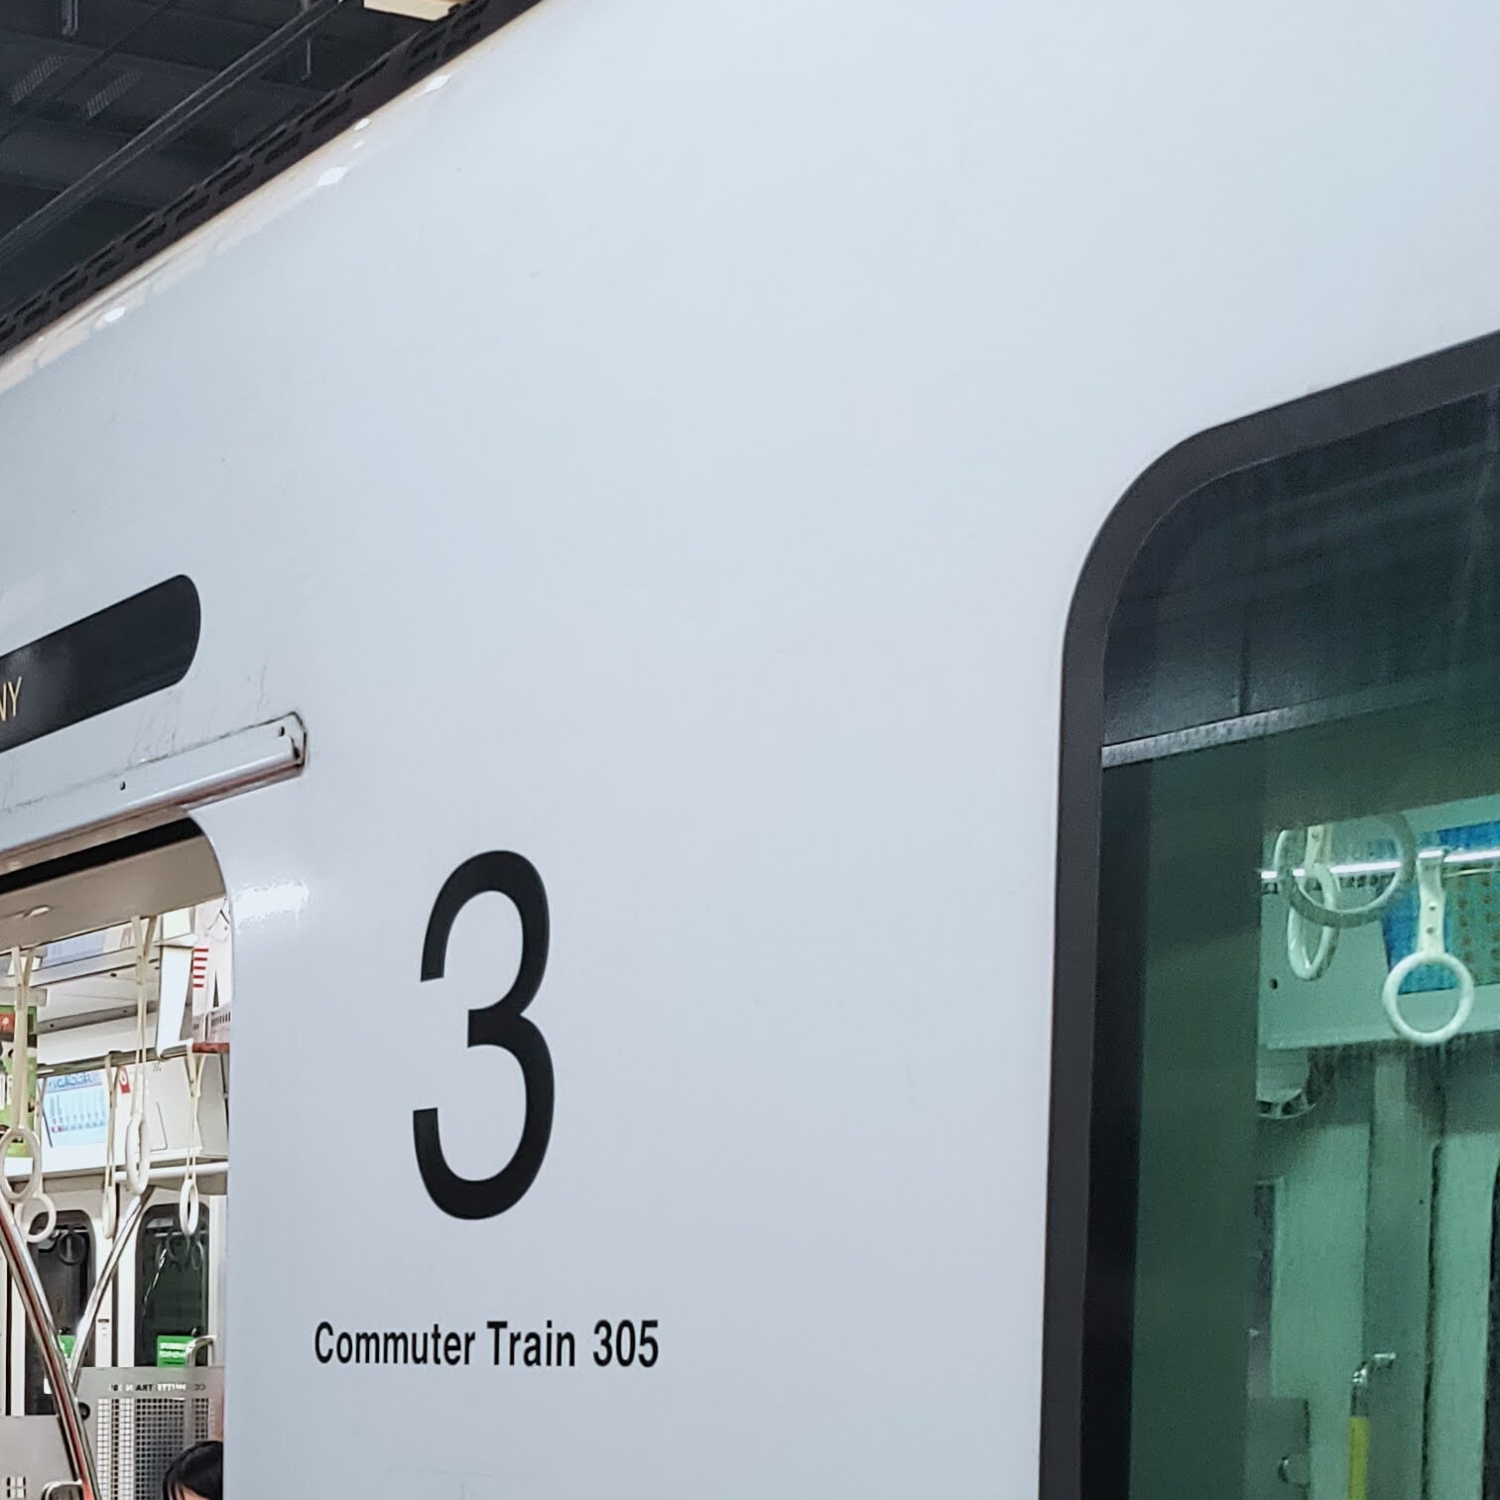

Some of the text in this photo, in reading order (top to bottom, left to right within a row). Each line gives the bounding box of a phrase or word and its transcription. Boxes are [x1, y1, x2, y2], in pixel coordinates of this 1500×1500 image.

[413, 849, 555, 1220] 3
[314, 1319, 659, 1368] Commuter Train 305
